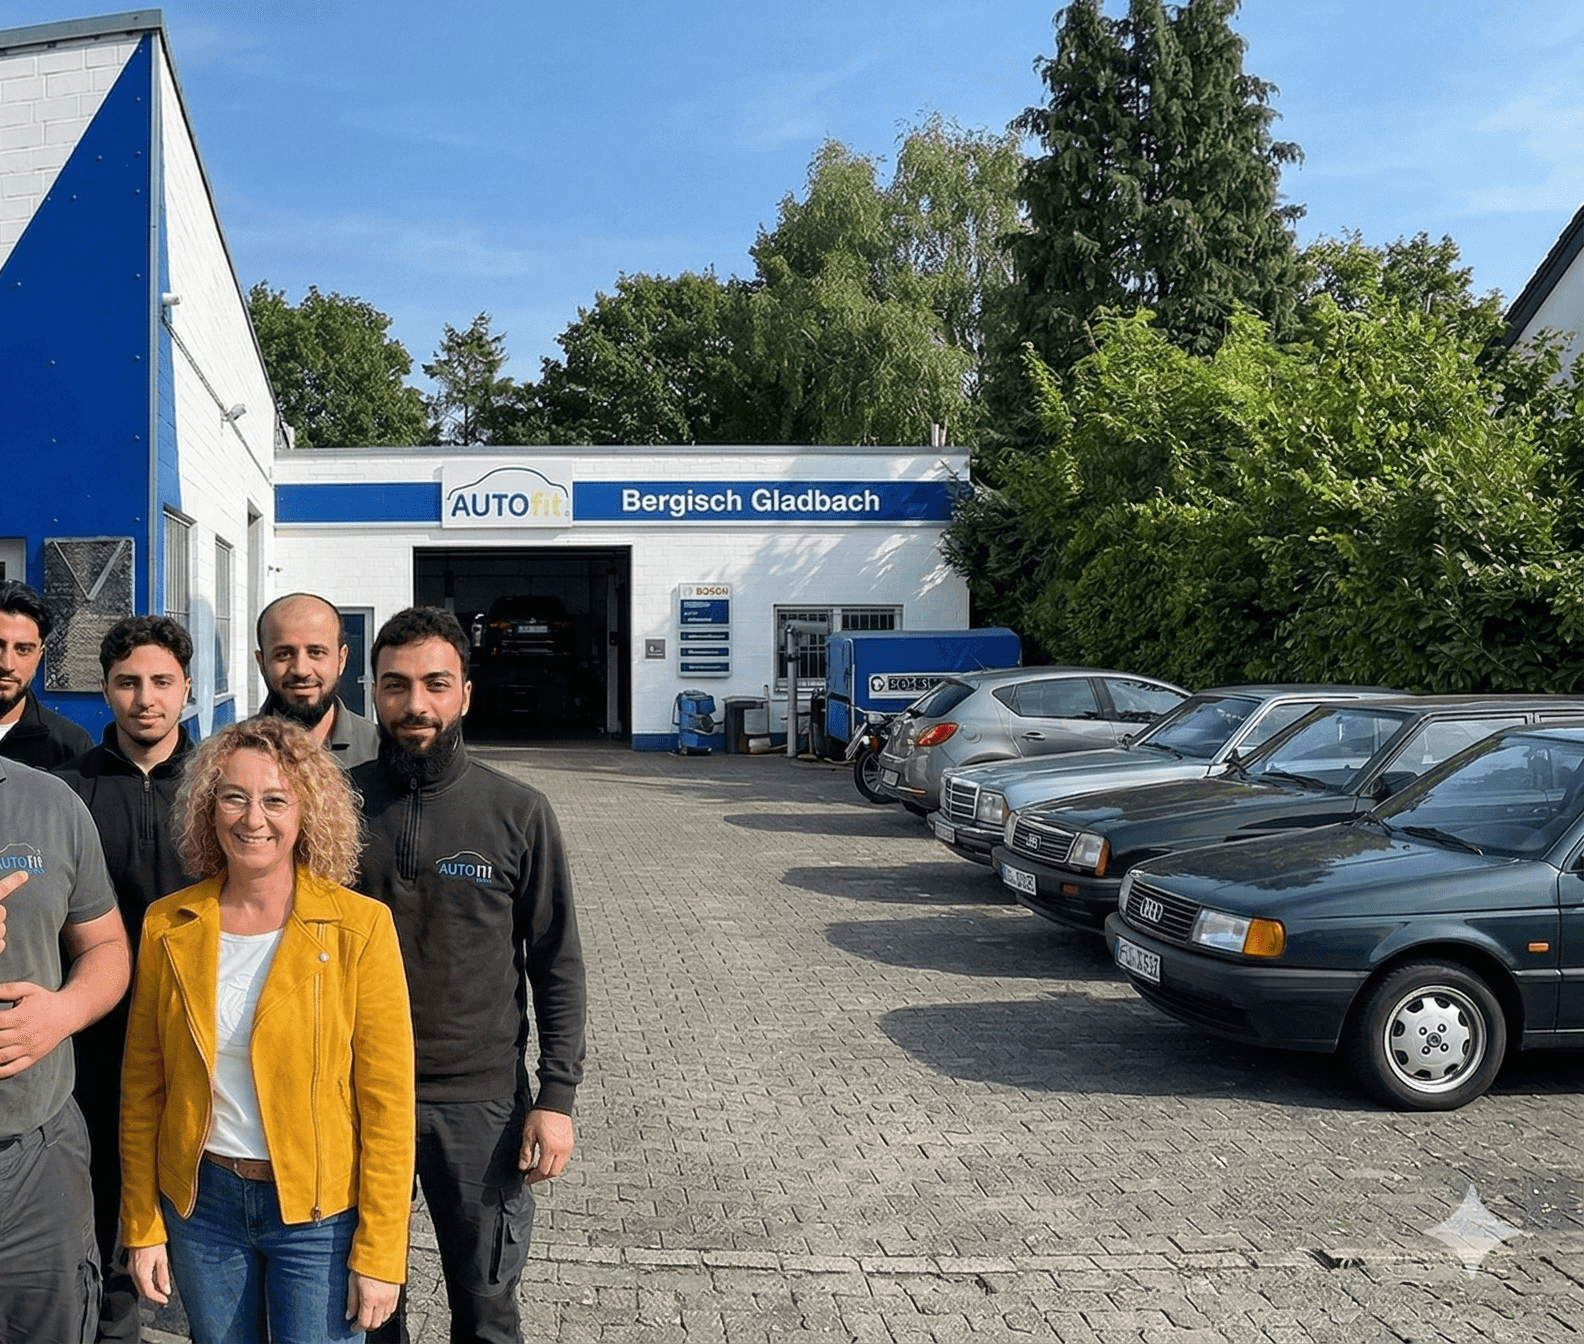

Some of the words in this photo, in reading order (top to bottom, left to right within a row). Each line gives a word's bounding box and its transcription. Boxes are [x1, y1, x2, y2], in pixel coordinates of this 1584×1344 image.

[451, 491, 563, 518] AUTOfit
[621, 489, 742, 518] Bergisch
[751, 488, 881, 512] Gladbach
